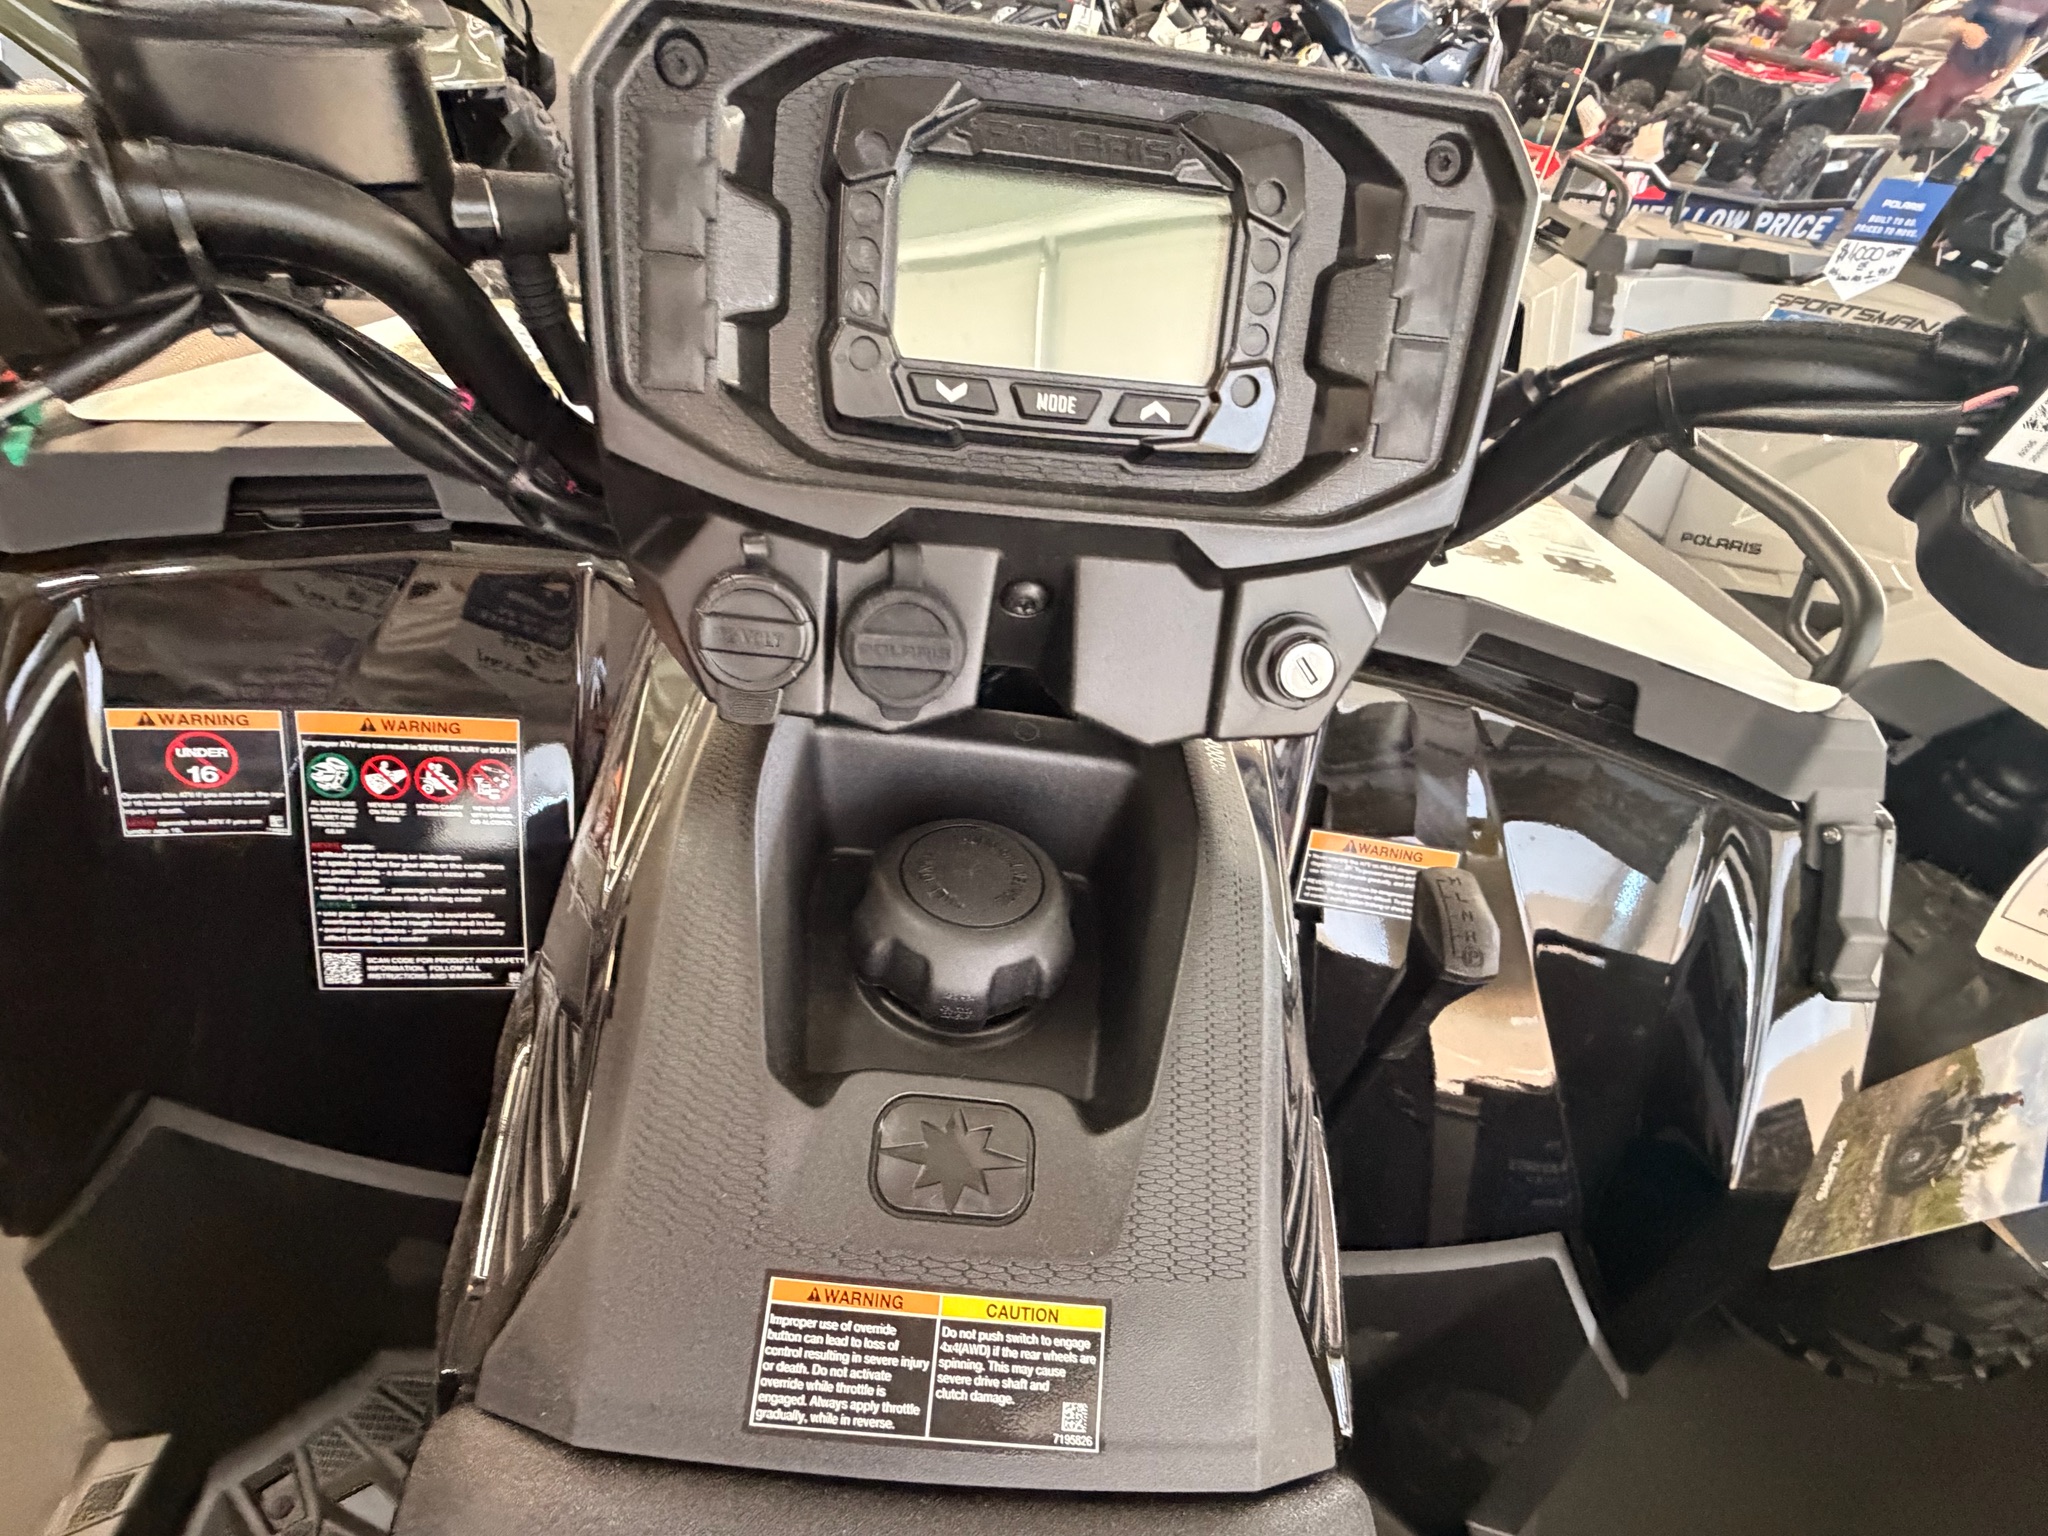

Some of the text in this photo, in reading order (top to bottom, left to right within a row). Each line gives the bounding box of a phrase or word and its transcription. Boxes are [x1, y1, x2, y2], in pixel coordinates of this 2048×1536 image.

[1755, 211, 1834, 240] PRICE
[1854, 223, 1883, 234] PRICED
[1884, 227, 1896, 236] TO
[1868, 214, 1893, 224] BUILT
[1893, 217, 1904, 226] TO
[1774, 293, 1941, 334] SPORTSMAN
[1036, 392, 1077, 414] MODE
[1681, 532, 1762, 555] POLARIS
[157, 714, 249, 726] WARNING
[381, 719, 461, 734] WARNING
[175, 747, 229, 758] UNDER
[186, 765, 219, 783] 16
[1359, 843, 1423, 863] WARNING
[824, 1288, 903, 1310] WARNING
[986, 1304, 1059, 1323] CAUTION
[770, 1313, 897, 1336] Improper use of override
[767, 1329, 900, 1351] button can lead to loss of
[942, 1326, 1091, 1350] Do not push switch to engage
[765, 1344, 930, 1372] control resulting in severe injury
[940, 1342, 1096, 1365] 4x4(AWD) if the rear wheels are
[762, 1361, 892, 1382] or death. Do not activate
[938, 1358, 1066, 1378] spinning. This may cause
[760, 1377, 886, 1397] override while throttle is
[937, 1374, 1050, 1392] severe drive shaft and
[758, 1392, 921, 1416] engaged. Always apply throttle
[935, 1388, 1015, 1407] clutch damage.
[755, 1408, 895, 1430] gradually, while in reverse.
[1053, 1433, 1093, 1446] 7195826
